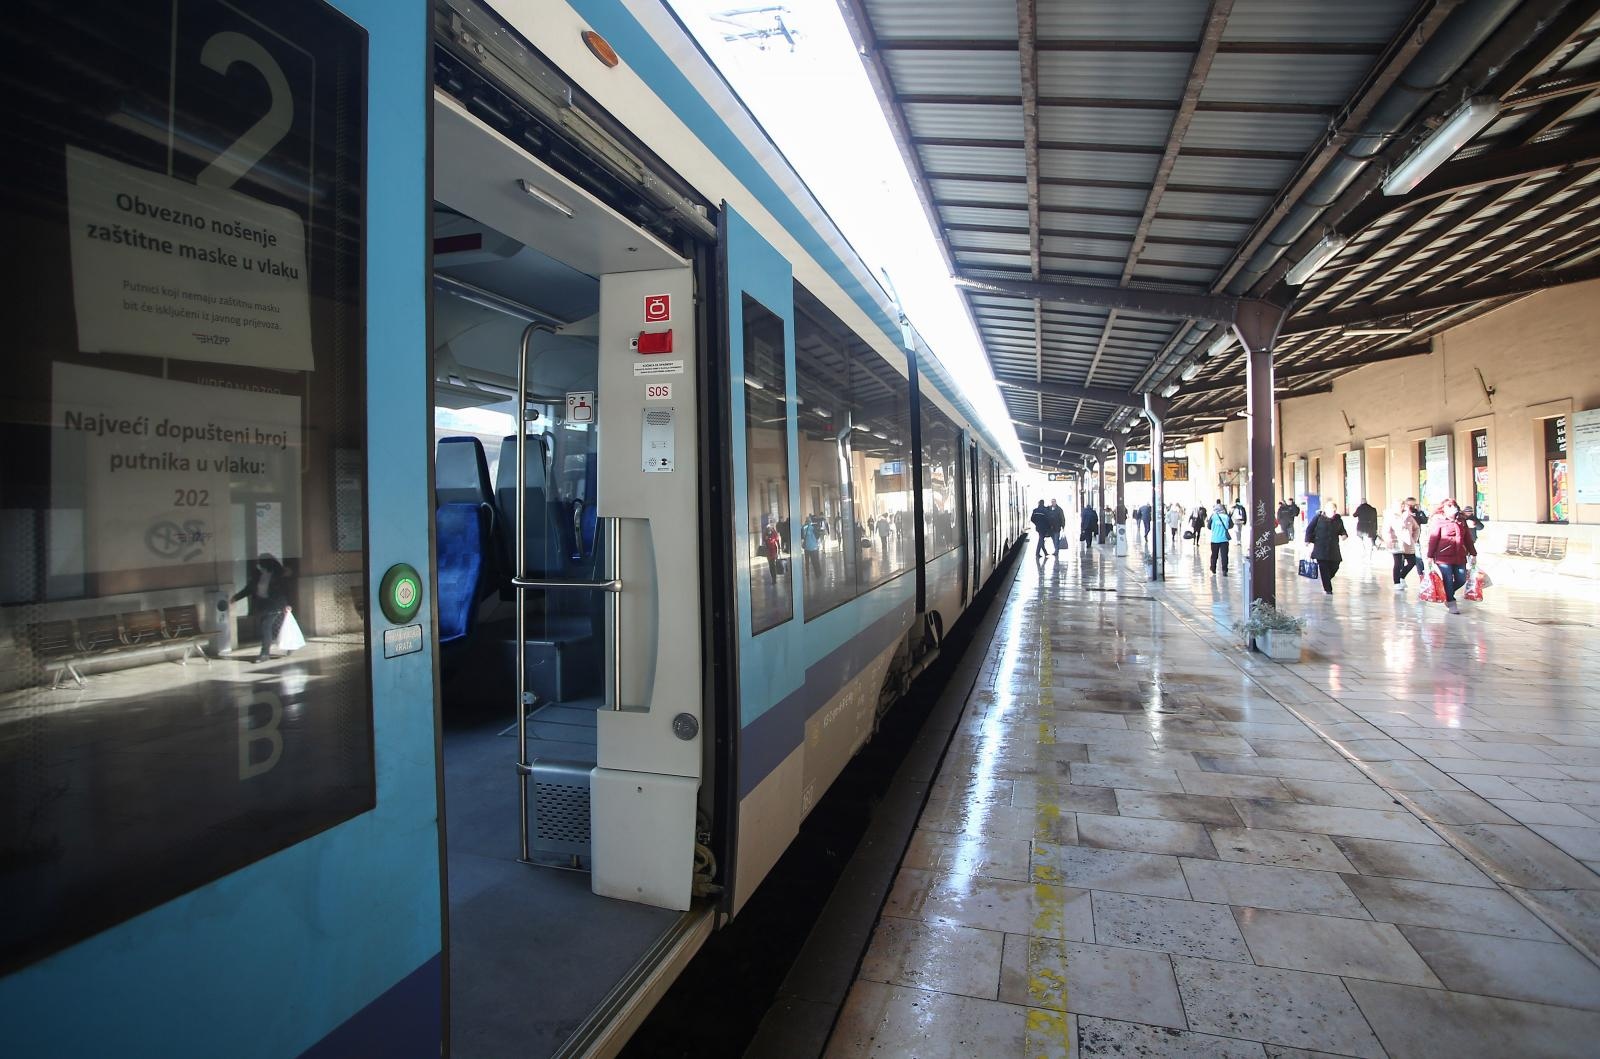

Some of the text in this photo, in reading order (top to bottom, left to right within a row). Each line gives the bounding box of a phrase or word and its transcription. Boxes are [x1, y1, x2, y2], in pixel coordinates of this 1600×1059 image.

[196, 31, 294, 189] 2
[116, 193, 277, 249] Obvezno nošenje
[87, 223, 299, 280] zaštitne maske u vlaku
[123, 280, 280, 313] Putnici koji nemaju zaštitnu masku
[123, 299, 282, 331] bit će isključeni iz javnog prijevoza.
[648, 386, 669, 397] SOS
[64, 410, 288, 450] Najveći dopušteni broj
[110, 451, 266, 475] putnika u vlaku:
[173, 488, 209, 507] 202
[239, 689, 284, 780] B
